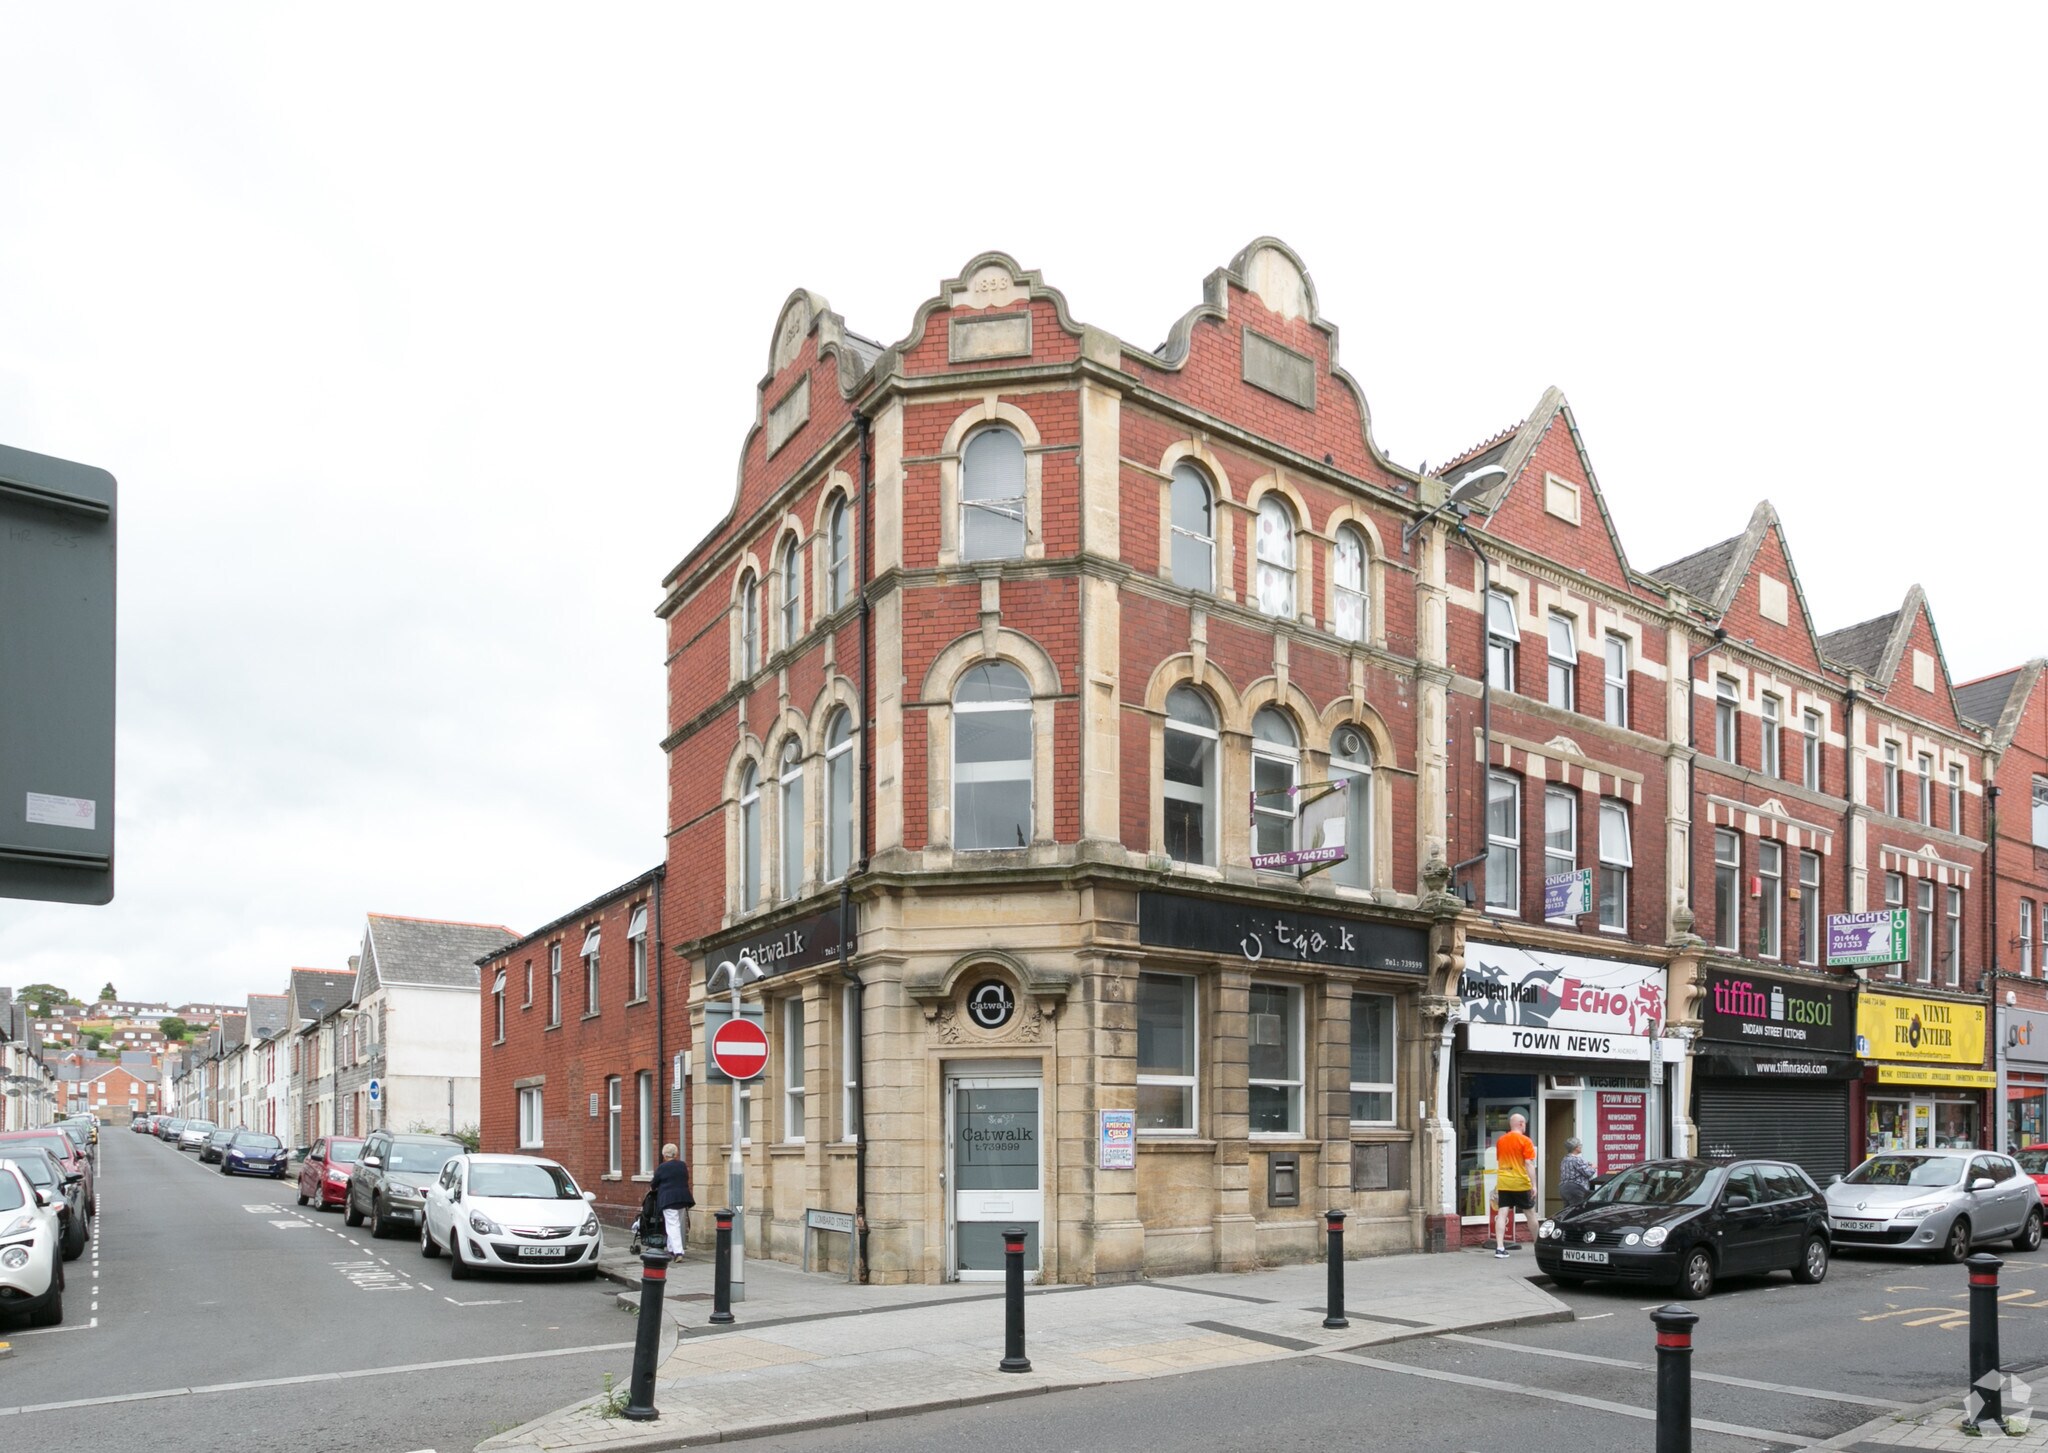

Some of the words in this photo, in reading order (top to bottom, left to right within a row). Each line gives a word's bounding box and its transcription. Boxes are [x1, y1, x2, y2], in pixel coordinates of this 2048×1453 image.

[1255, 853, 1287, 867] 01446
[1296, 848, 1336, 862] 744750
[1833, 911, 1890, 925] KNIGHTS
[1893, 910, 1905, 929] TO
[1832, 941, 1863, 949] 701333
[1834, 934, 1860, 942] 01446
[1895, 931, 1903, 960] LET
[1384, 957, 1399, 967] Tel:
[1401, 960, 1423, 969] 739599
[1829, 954, 1889, 965] COMMERCIAL
[1510, 982, 1538, 1004] Mail
[1560, 978, 1628, 1016] ECHO
[969, 1000, 1013, 1010] Catwalk
[1713, 979, 1768, 1019] tiffin
[1787, 994, 1833, 1027] rasoi
[1895, 1006, 1910, 1020] THE
[1923, 1004, 1952, 1024] VINYL
[1975, 1010, 1983, 1022] 39
[1742, 1023, 1764, 1036] INDIAN
[1764, 1025, 1784, 1038] STREET
[1784, 1027, 1807, 1041] KITCHEN
[1512, 1031, 1560, 1050] TOWN
[1567, 1036, 1610, 1054] NEWS
[1756, 1060, 1828, 1075] www.tiffinrasoi.com
[1602, 1094, 1622, 1103] TOWN
[1623, 1095, 1642, 1104] NEWS
[962, 1127, 1033, 1142] Catwalk
[1604, 1143, 1639, 1151] CONFECTIONERY
[1607, 1153, 1619, 1161] SOFT
[1840, 1221, 1857, 1229] HK10
[1859, 1222, 1875, 1230] SKF
[523, 1247, 542, 1255] CE14
[544, 1247, 561, 1256] JKX
[1565, 1250, 1586, 1261] NV04
[1587, 1252, 1605, 1262] HLD
